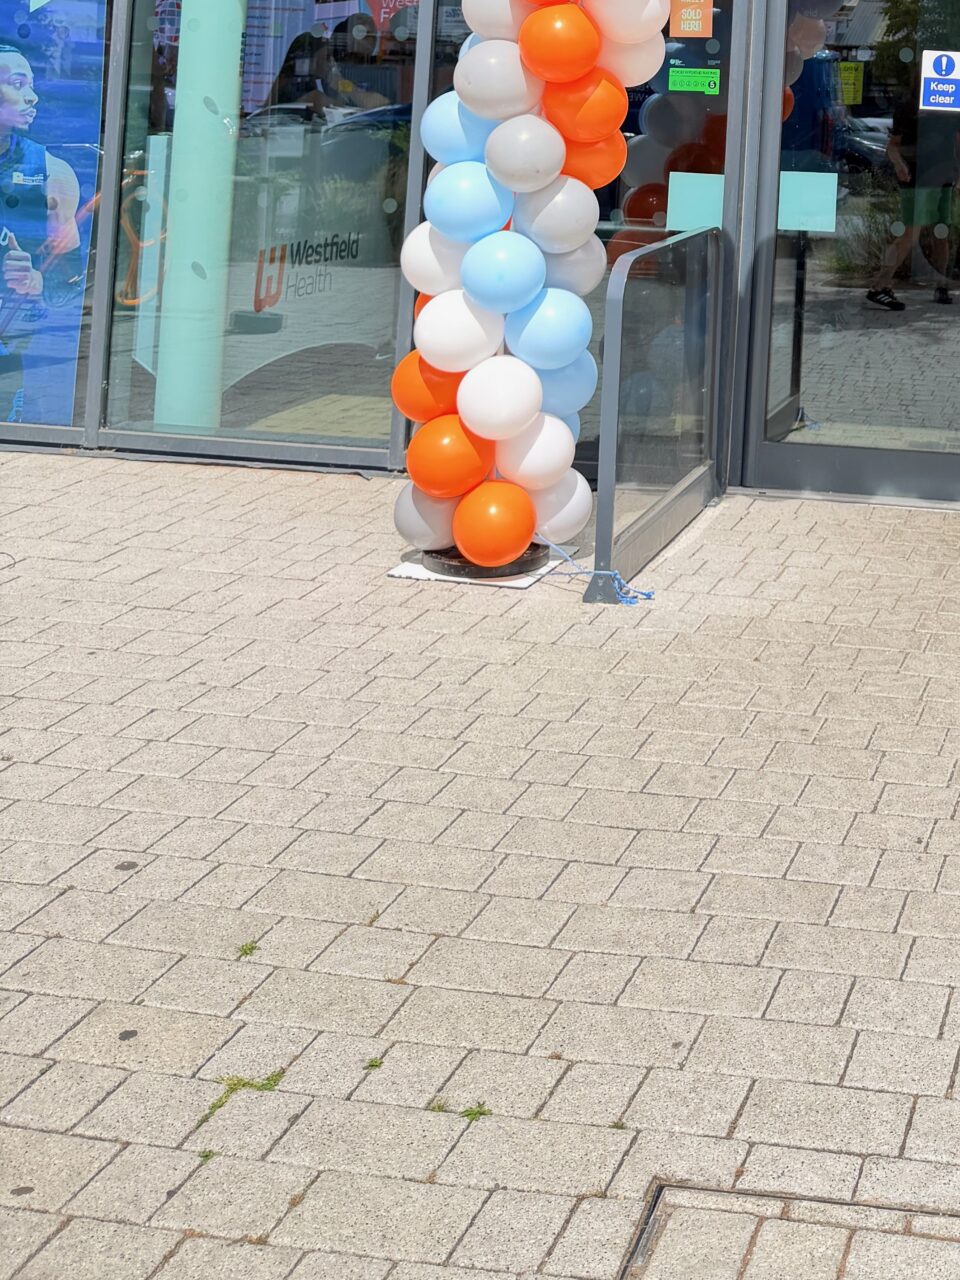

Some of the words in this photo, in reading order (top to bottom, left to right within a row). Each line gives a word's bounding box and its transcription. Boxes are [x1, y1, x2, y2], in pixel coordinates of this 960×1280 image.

[681, 8, 702, 20] SOLD
[680, 20, 702, 32] HERE!
[930, 81, 956, 93] Keep
[929, 94, 954, 104] clear
[290, 231, 360, 268] Westfield
[285, 264, 333, 301] Health
